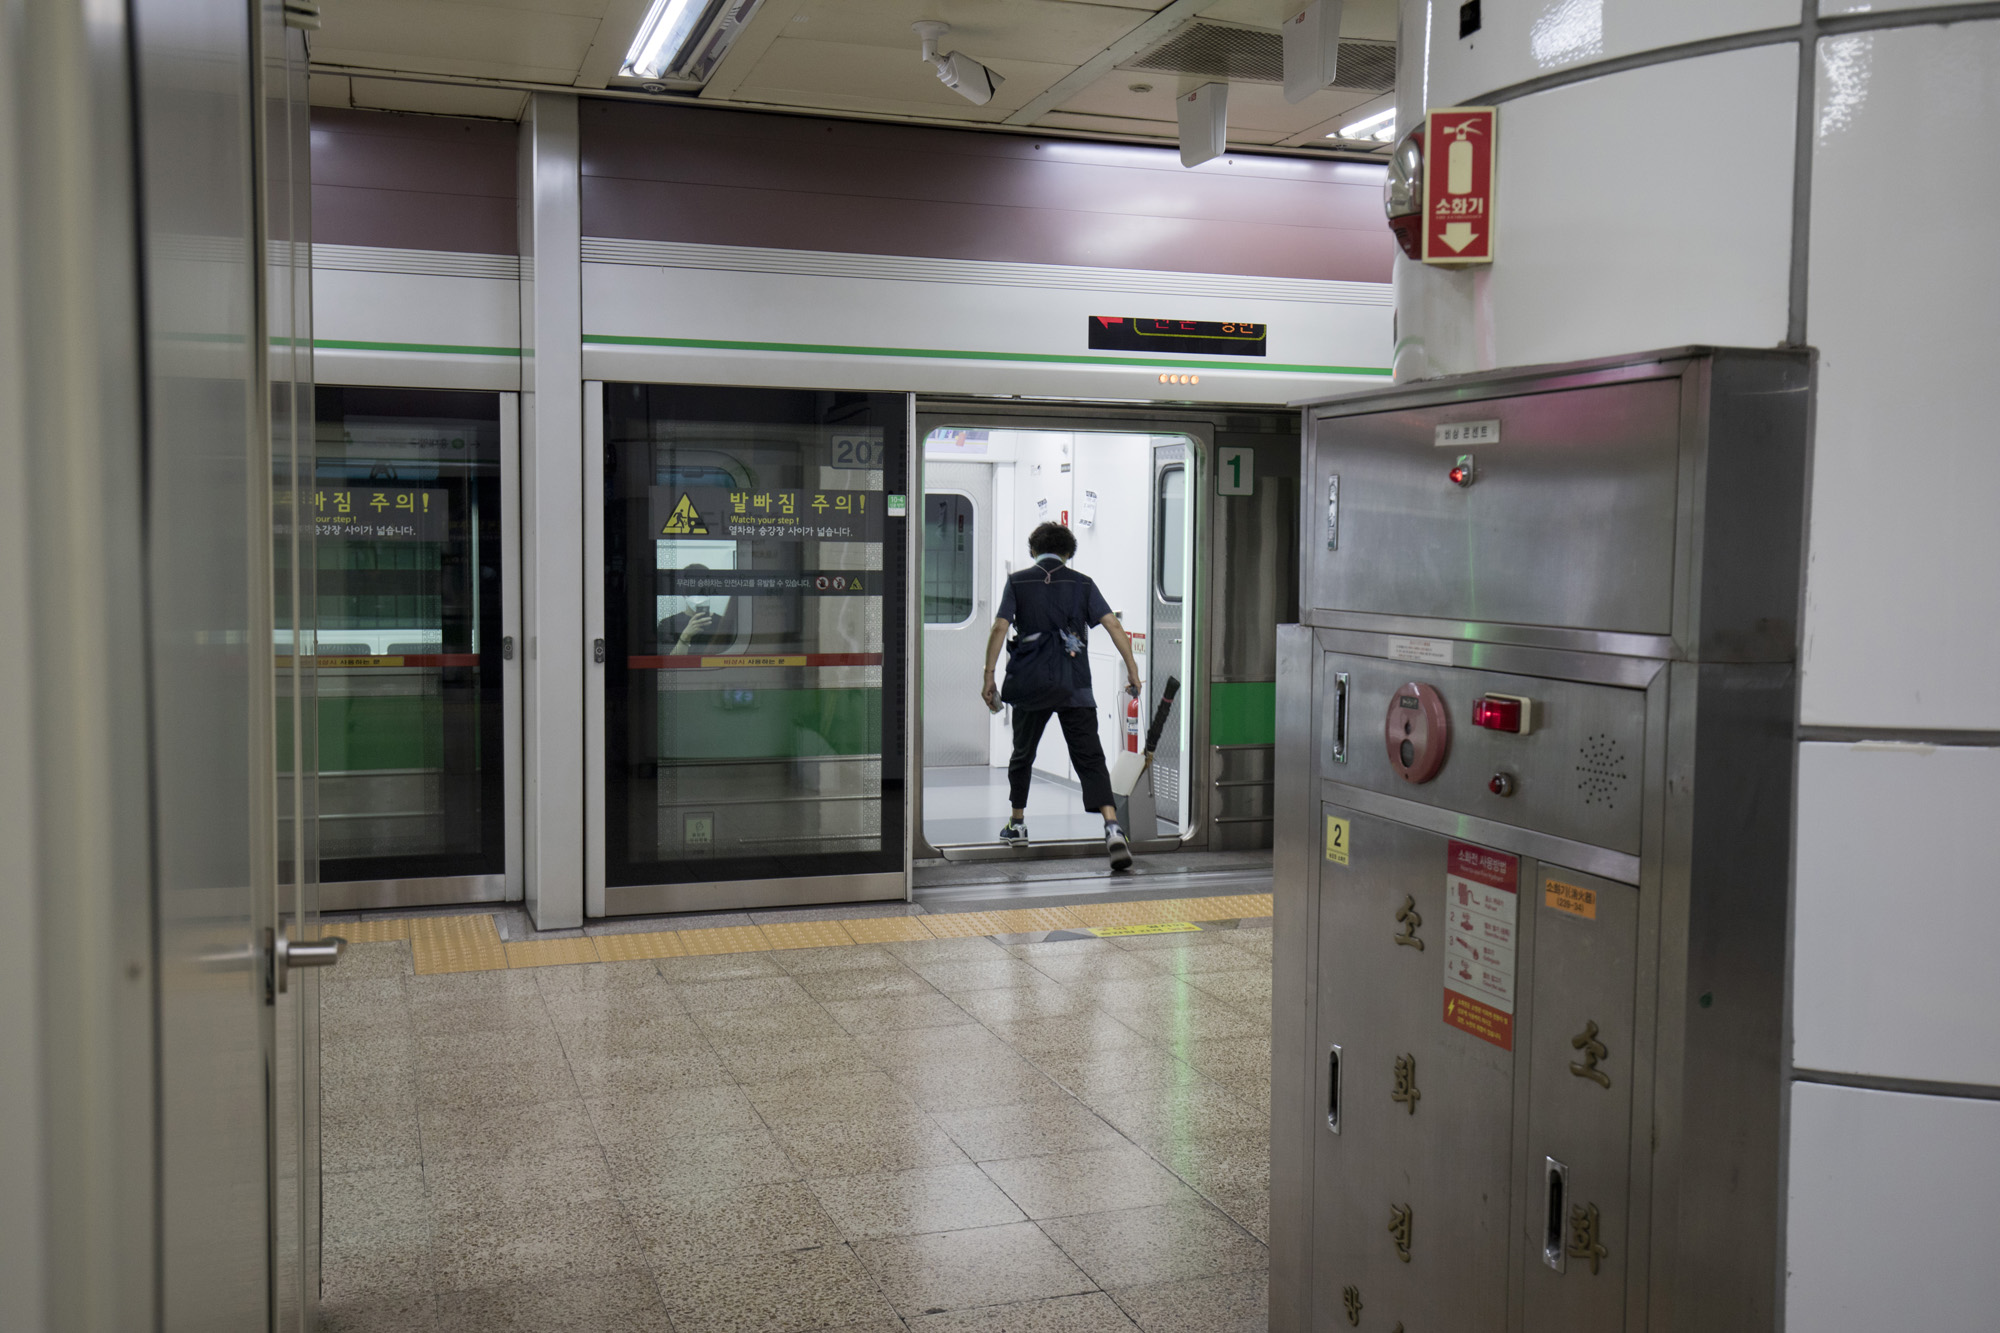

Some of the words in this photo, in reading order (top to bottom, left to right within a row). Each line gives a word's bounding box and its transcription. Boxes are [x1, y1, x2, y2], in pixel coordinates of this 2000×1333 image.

[1435, 197, 1484, 215] 소화기
[1226, 454, 1241, 488] 1
[369, 492, 430, 513] 주의!
[729, 491, 796, 514] 발빠짐
[811, 494, 866, 515] 주의!
[730, 515, 756, 525] Watch
[757, 517, 776, 526] your
[344, 525, 373, 536] 사이가
[376, 525, 417, 536] 넓습니다.
[728, 525, 756, 537] 열차와
[758, 525, 785, 537] 승강장
[787, 526, 814, 537] 사이가
[816, 526, 853, 538] 넓습니다.
[676, 578, 697, 588] 무리한
[697, 578, 723, 588] 승하차는
[723, 578, 756, 588] 안전사고를
[756, 578, 776, 588] 유발할
[776, 578, 784, 588] 수
[784, 578, 811, 588] 있습니다.
[339, 657, 370, 665] 사용하는
[373, 657, 380, 665] 문
[1333, 823, 1342, 848] 2
[1458, 849, 1478, 866] 소화전
[1479, 855, 1507, 875] 사용방법
